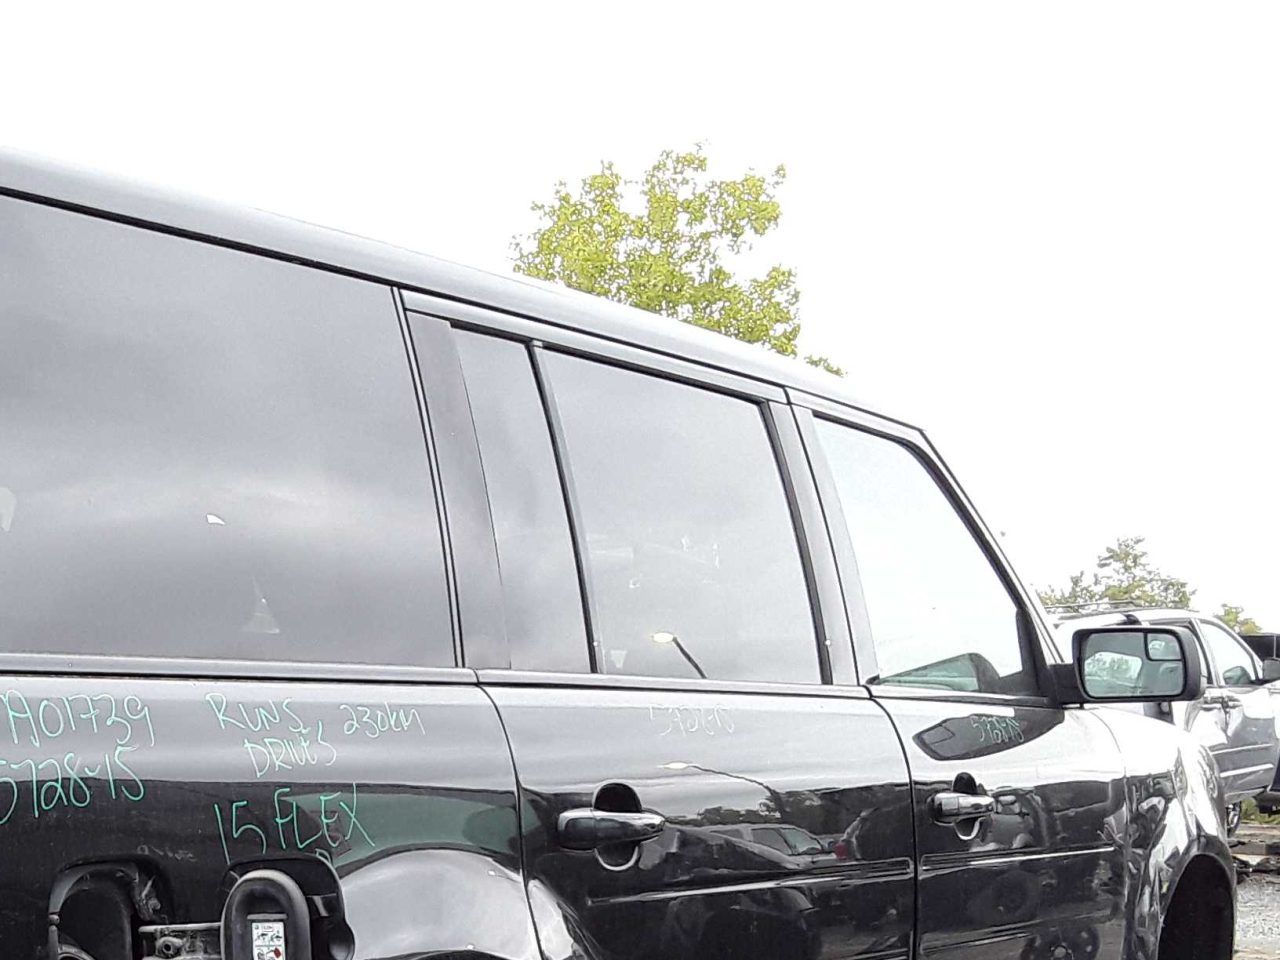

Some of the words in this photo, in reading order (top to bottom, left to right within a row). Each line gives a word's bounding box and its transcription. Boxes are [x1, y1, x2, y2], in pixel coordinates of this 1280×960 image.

[205, 692, 304, 732] RUNS
[213, 800, 267, 866] 15
[273, 781, 376, 849] FLEX
